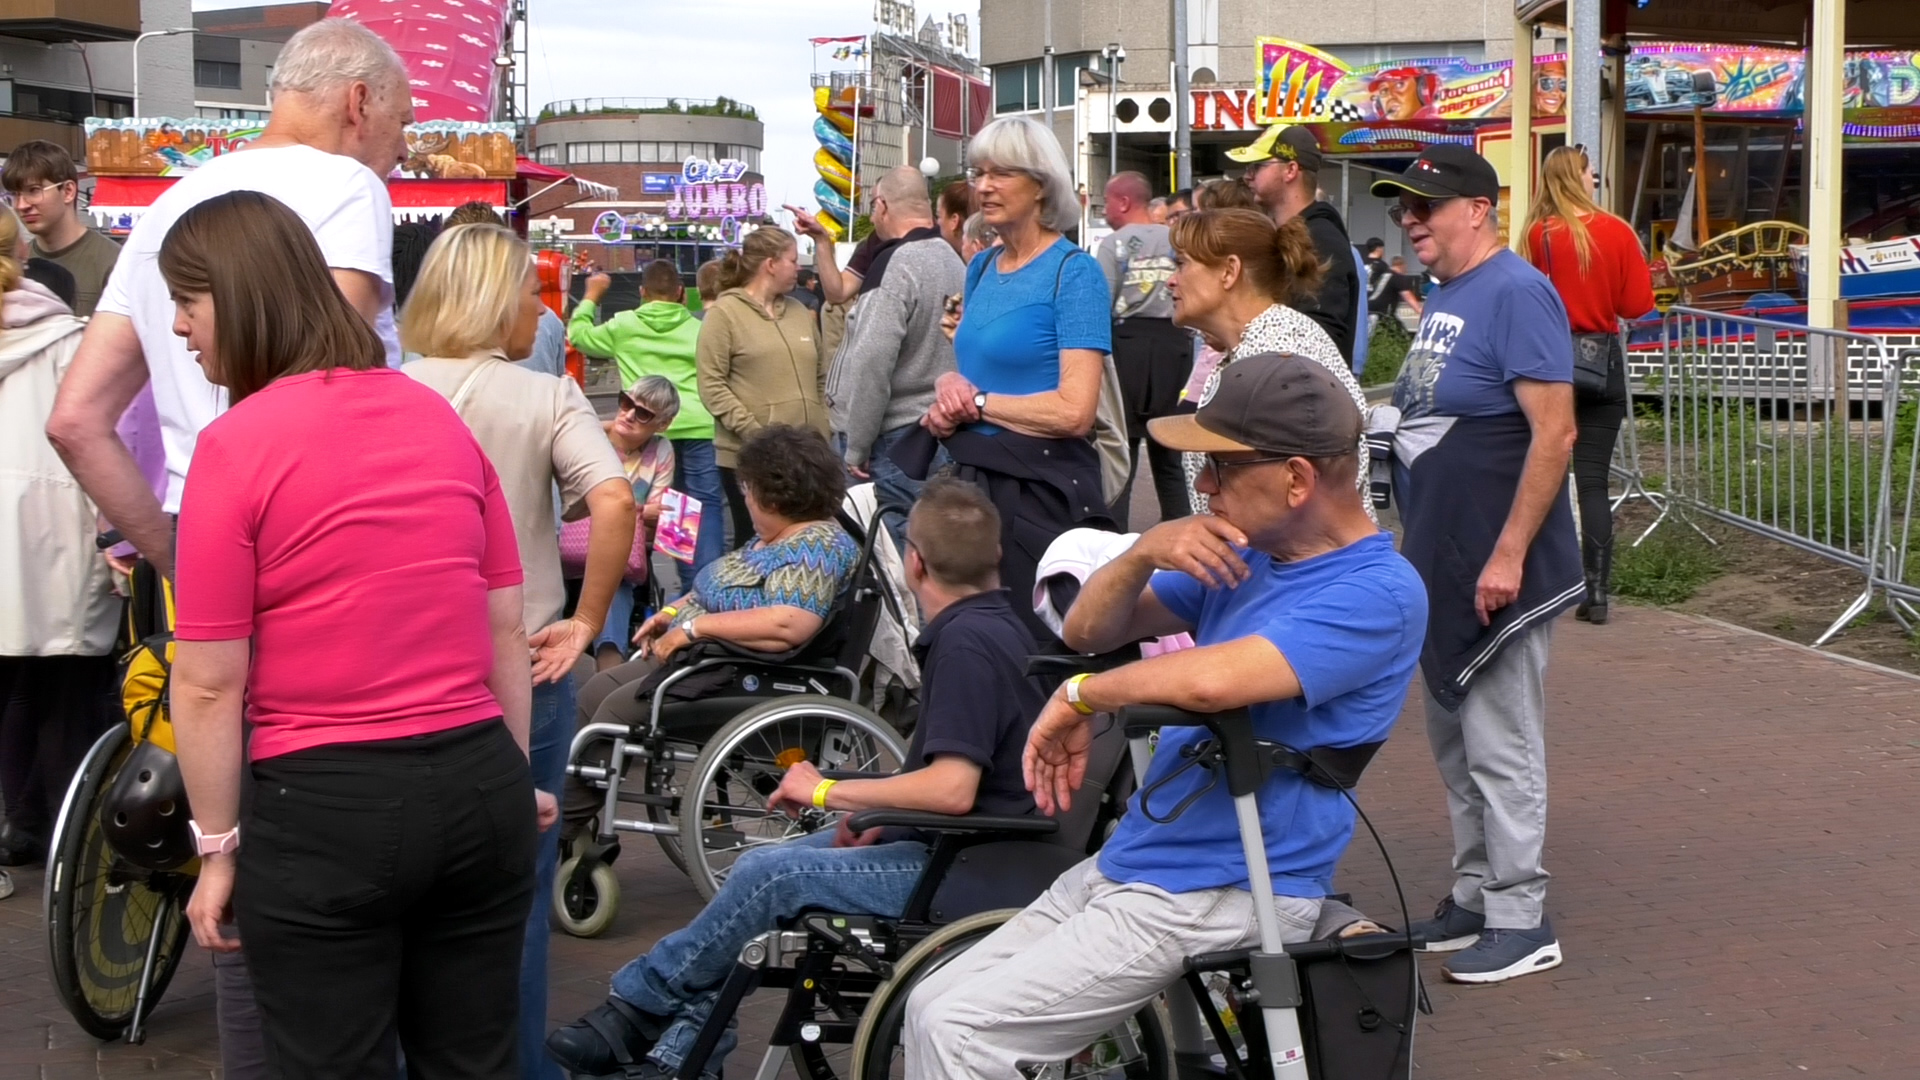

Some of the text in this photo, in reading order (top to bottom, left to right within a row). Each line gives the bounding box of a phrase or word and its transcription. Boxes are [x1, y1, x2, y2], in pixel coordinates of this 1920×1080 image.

[1190, 91, 1256, 129] IN
[683, 156, 748, 184] CRAZY
[667, 184, 767, 218] JUMBO
